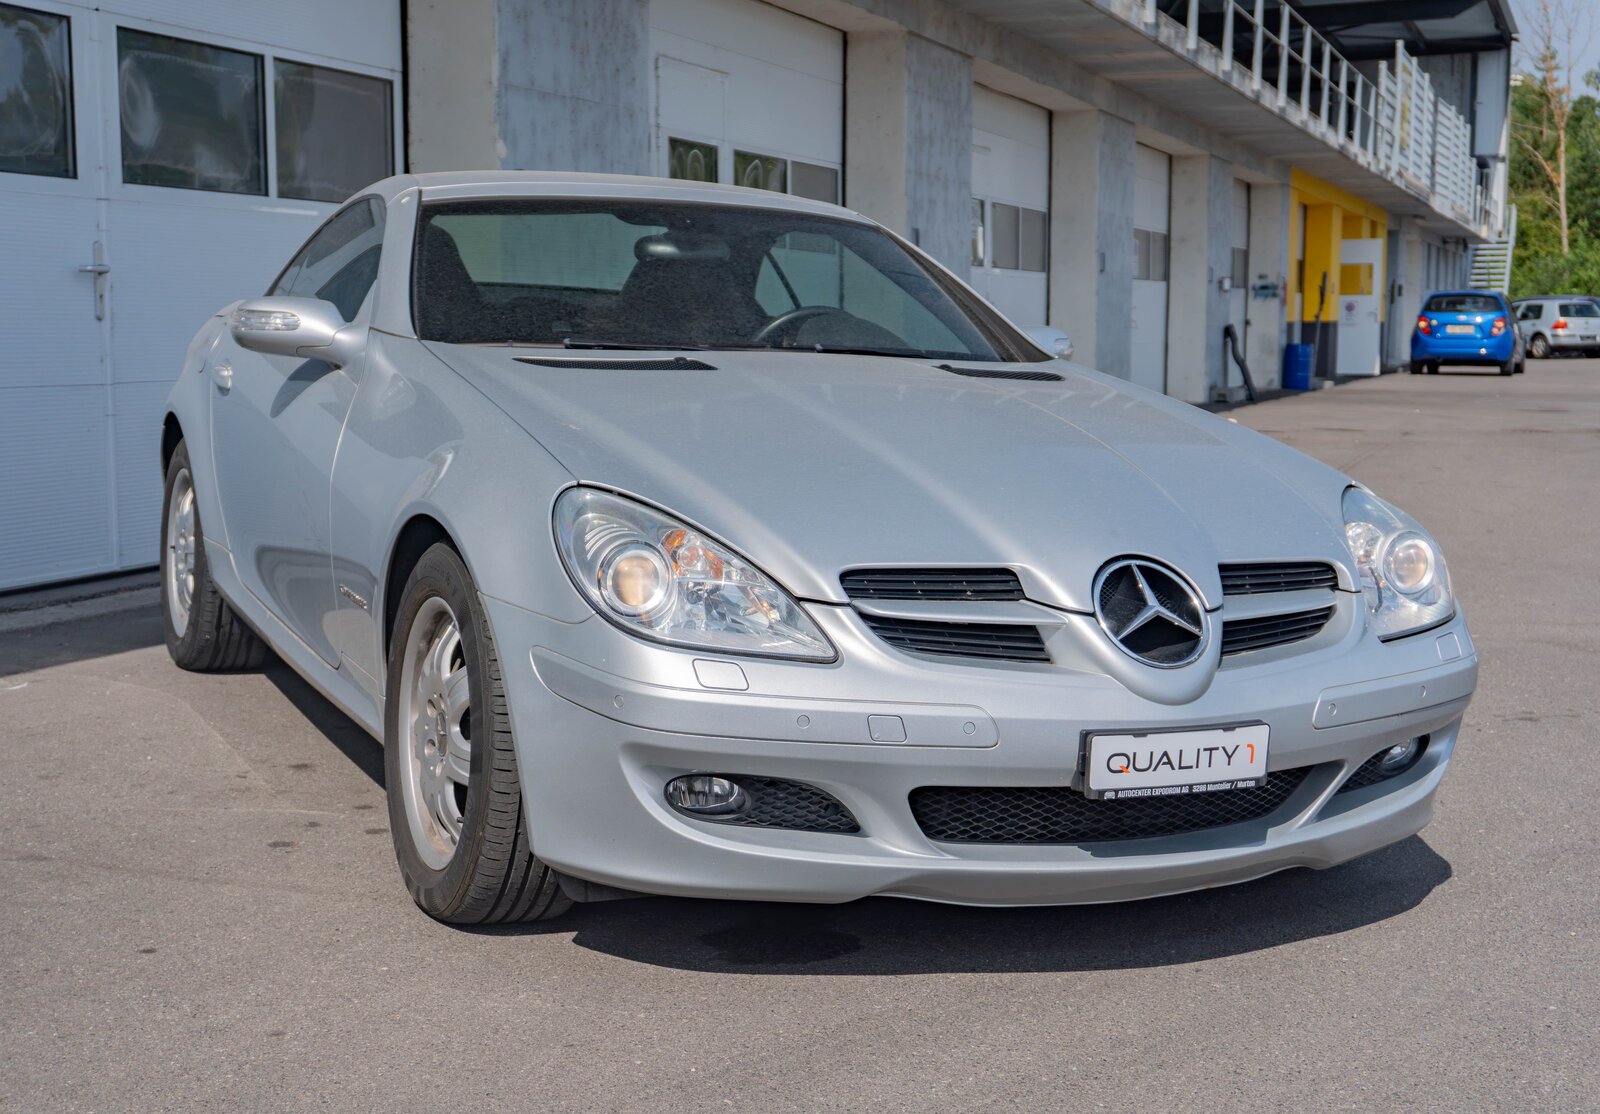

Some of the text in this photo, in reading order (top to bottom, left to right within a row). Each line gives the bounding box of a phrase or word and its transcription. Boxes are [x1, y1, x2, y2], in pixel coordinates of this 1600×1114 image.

[1117, 788, 1152, 798] AUTOCENTER
[1152, 786, 1181, 796] EXPODROM
[1181, 785, 1190, 794] AG
